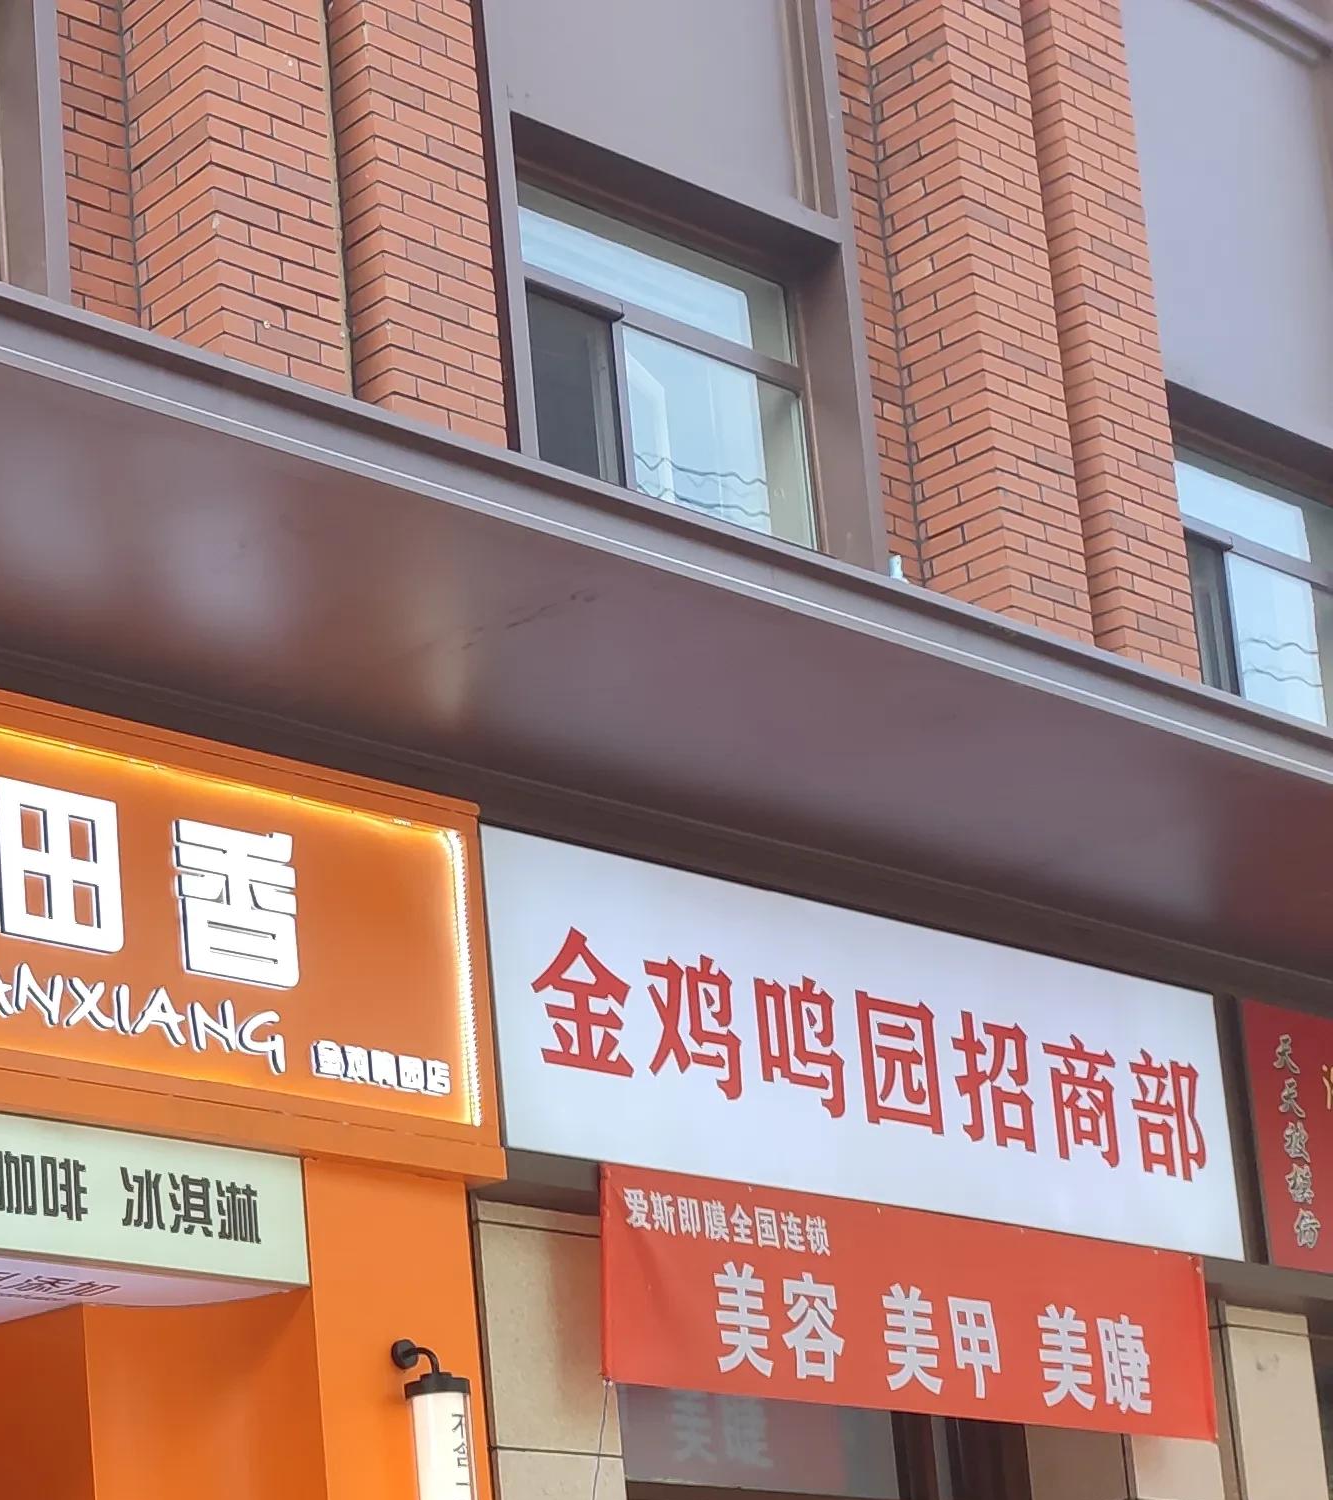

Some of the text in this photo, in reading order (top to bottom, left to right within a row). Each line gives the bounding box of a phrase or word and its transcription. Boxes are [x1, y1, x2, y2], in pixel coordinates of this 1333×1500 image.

[530, 925, 1208, 1183] 金鸡鸣园招商部
[120, 1165, 262, 1245] 冰淇淋
[713, 1261, 1153, 1417] 美容 美甲 美睫
